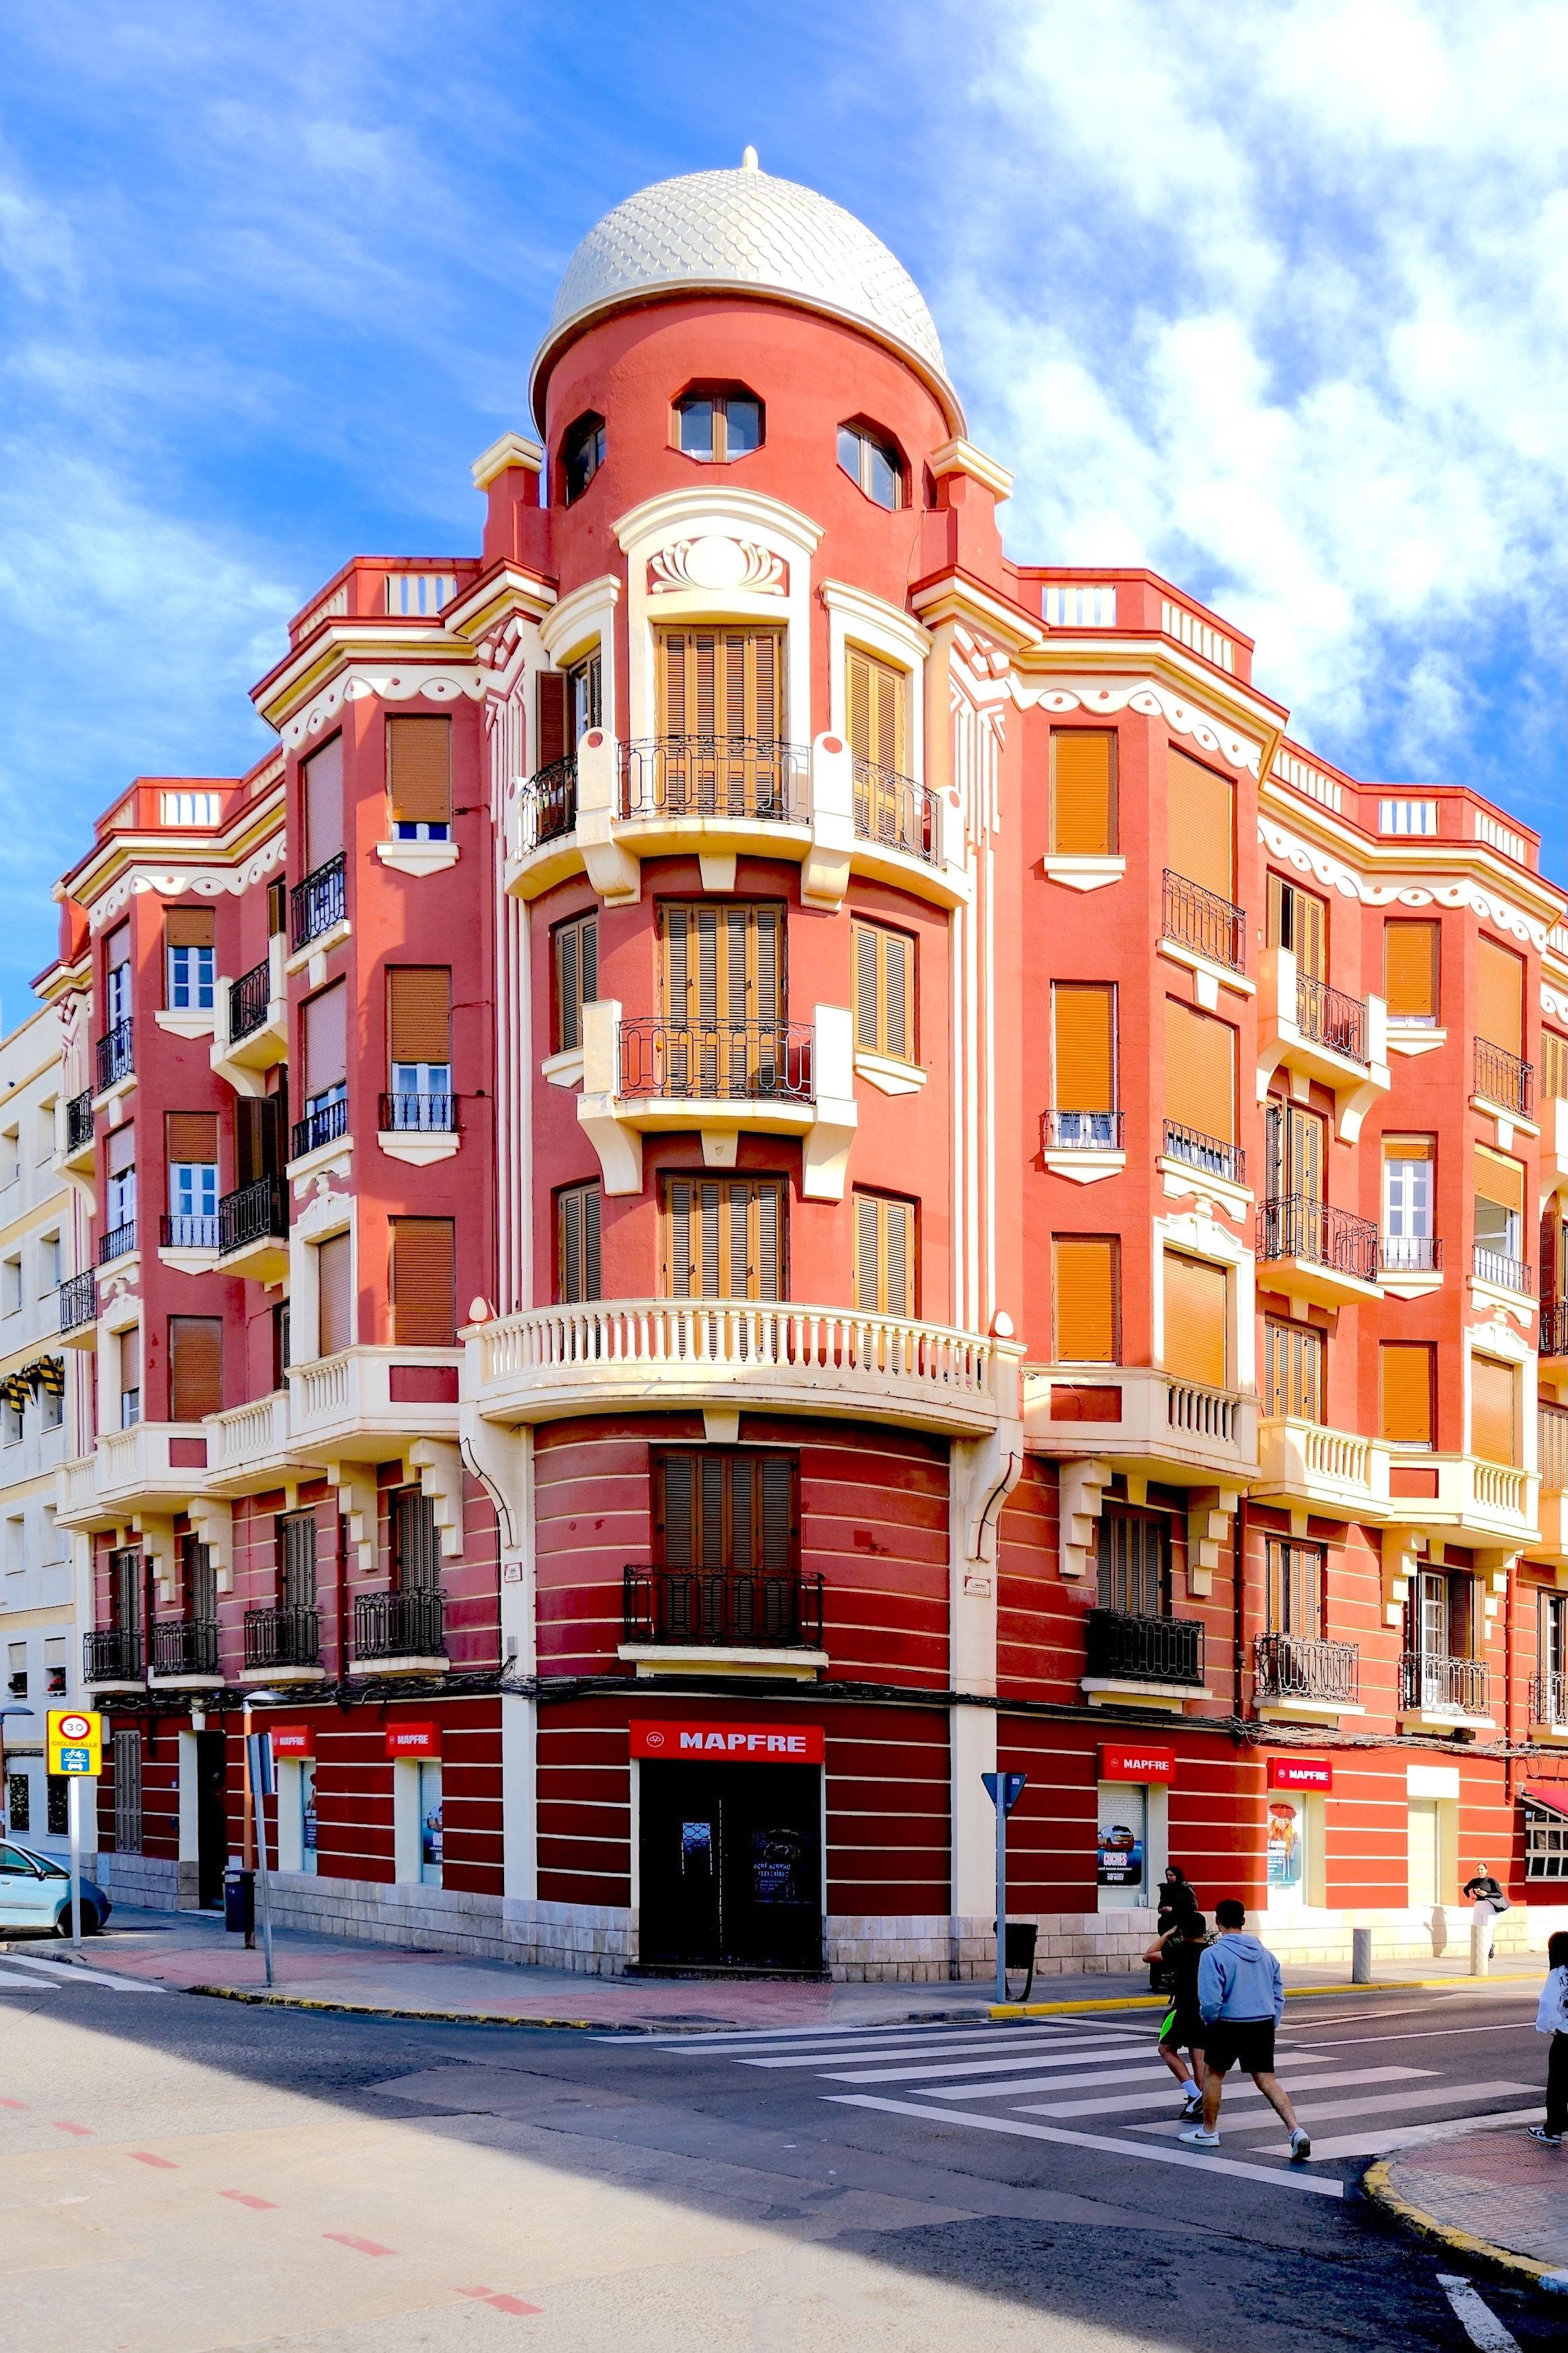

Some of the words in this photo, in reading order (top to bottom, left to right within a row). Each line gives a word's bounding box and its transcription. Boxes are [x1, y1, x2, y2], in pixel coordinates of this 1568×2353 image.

[67, 1723, 83, 1731] 30
[279, 1737, 306, 1746] MAPFRE
[397, 1734, 429, 1745] MAPFRE
[680, 1732, 807, 1753] MAPFRE
[1123, 1758, 1169, 1771] MAPFRE
[1289, 1769, 1329, 1781] MAPFRE
[1103, 1852, 1128, 1866] COCHES
